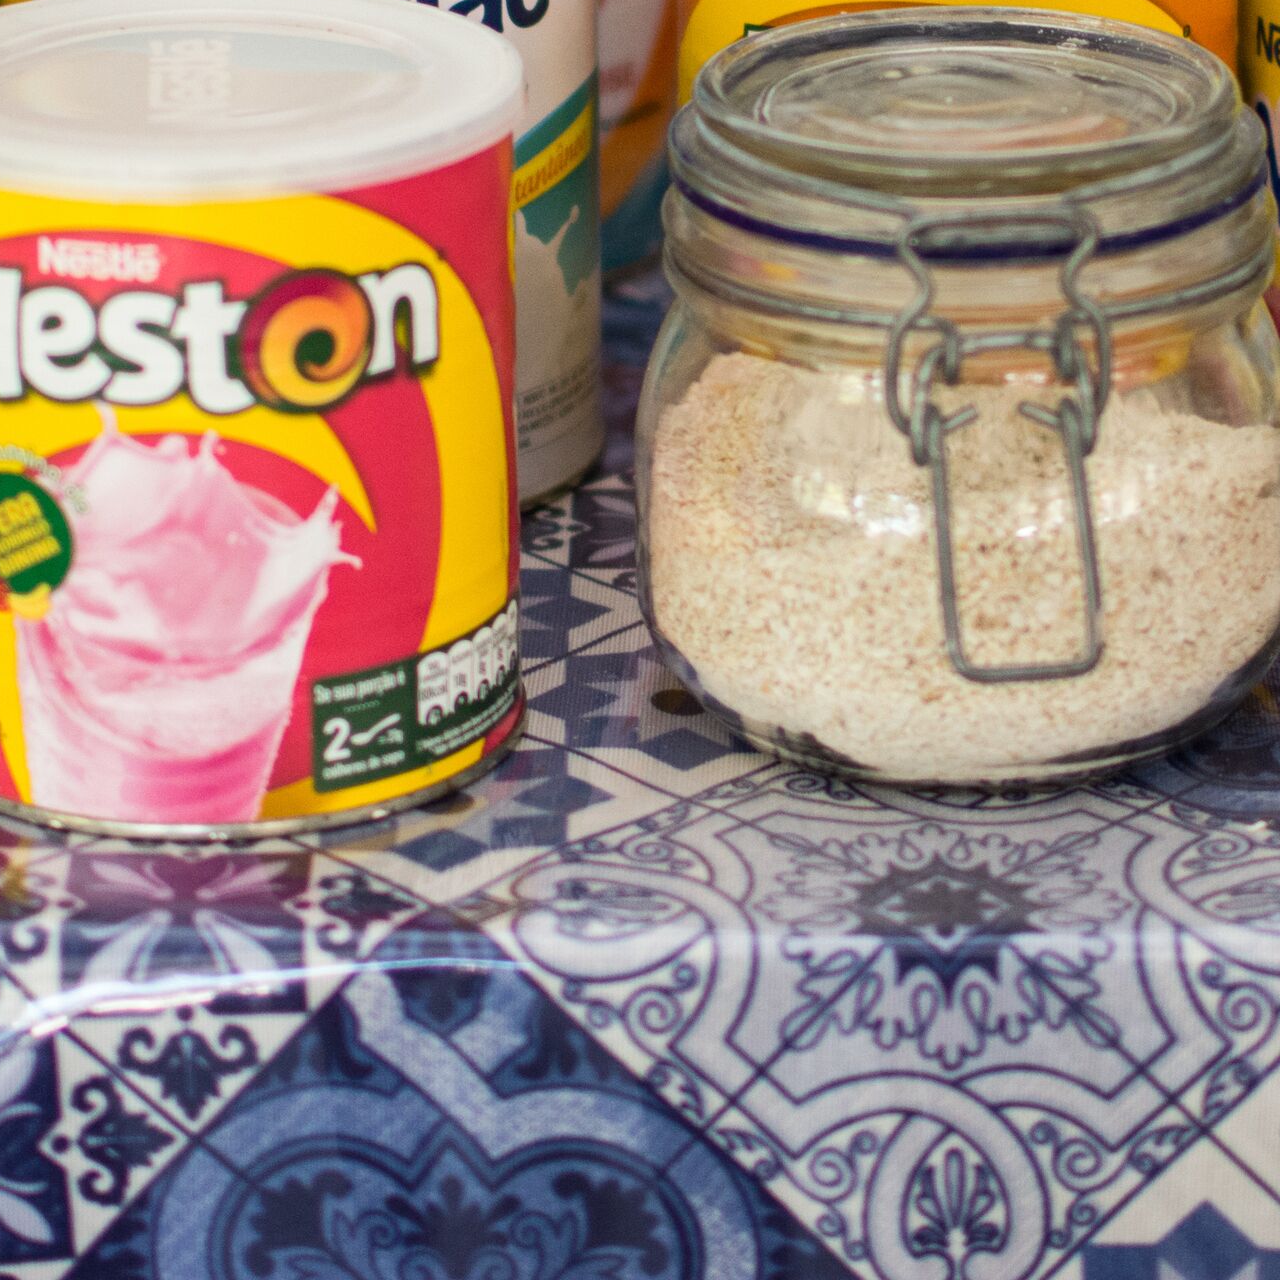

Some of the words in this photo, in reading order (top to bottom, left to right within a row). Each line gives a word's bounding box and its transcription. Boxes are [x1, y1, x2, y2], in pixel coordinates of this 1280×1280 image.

[313, 683, 332, 705] Se
[333, 683, 356, 702] sua
[323, 716, 352, 762] 2
